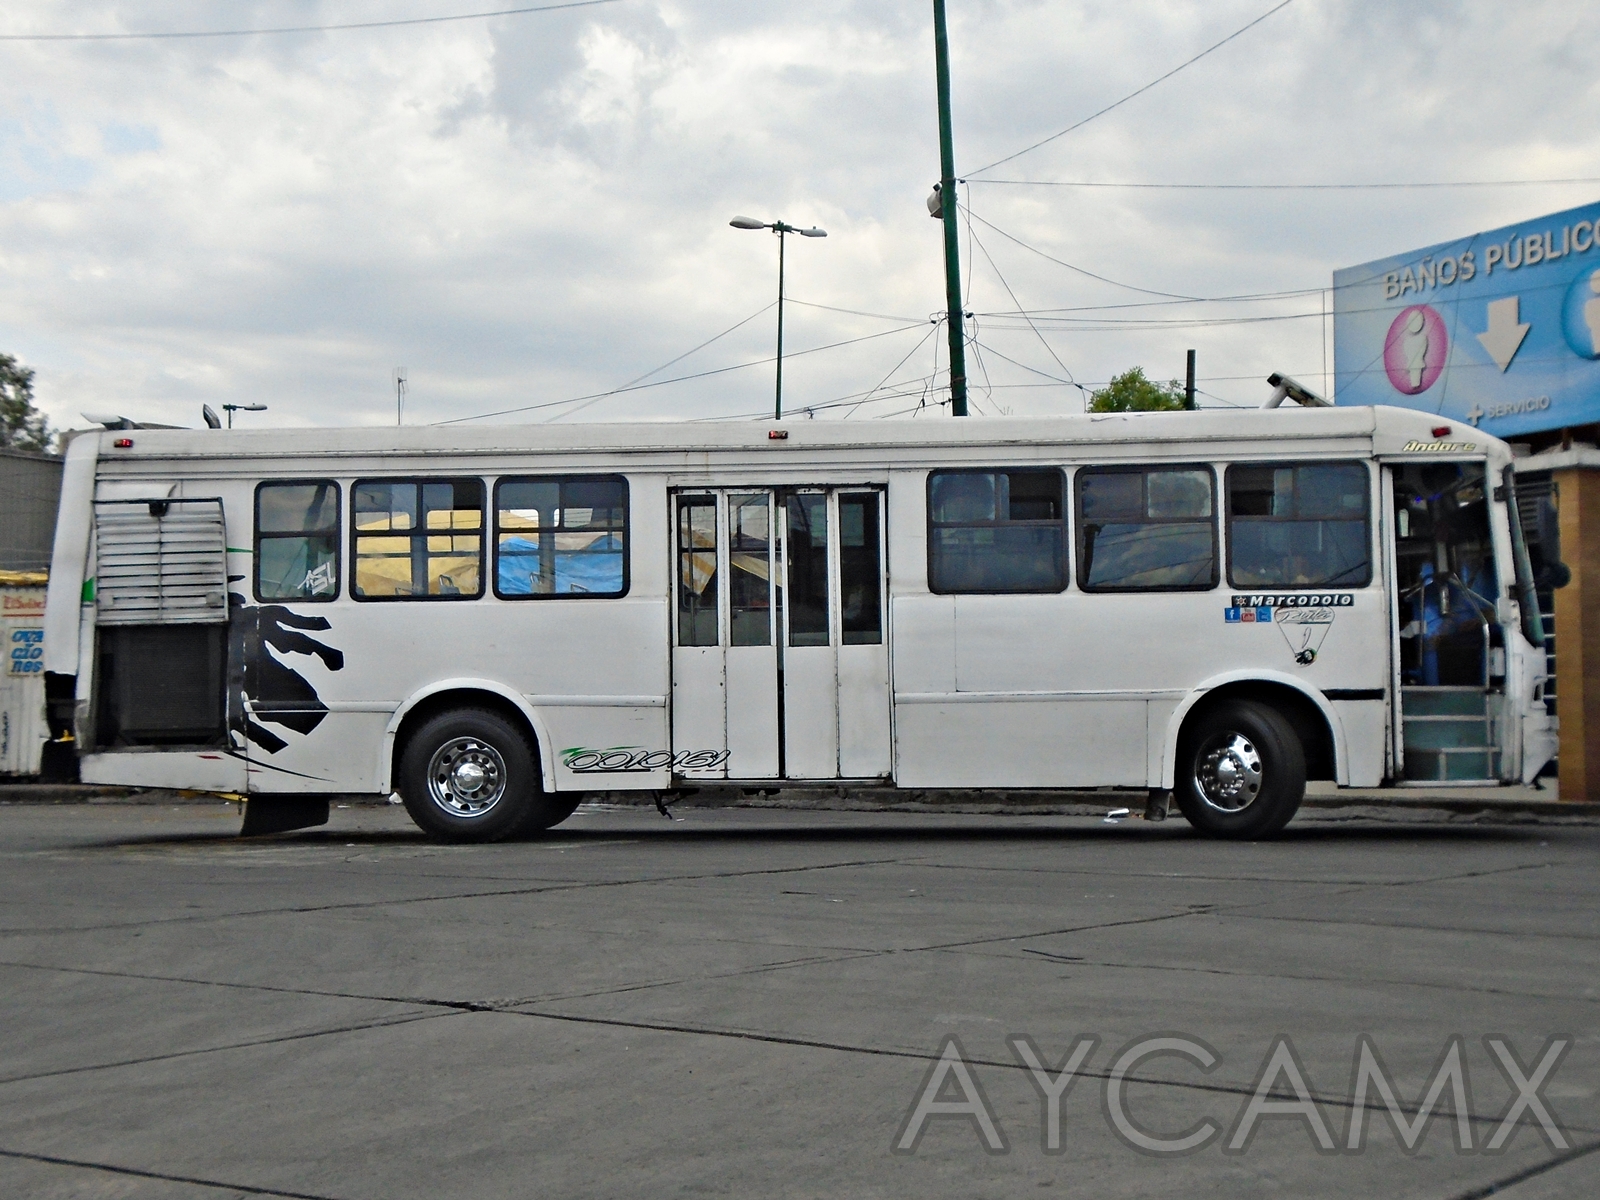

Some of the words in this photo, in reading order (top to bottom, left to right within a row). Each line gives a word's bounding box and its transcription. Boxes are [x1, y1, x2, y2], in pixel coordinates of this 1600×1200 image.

[1383, 251, 1476, 300] BAÑOS
[1486, 217, 1600, 275] PÚBLIC
[1487, 395, 1551, 419] SERVICIO
[1402, 439, 1477, 452] Andare
[1249, 594, 1352, 607] Marcopolo
